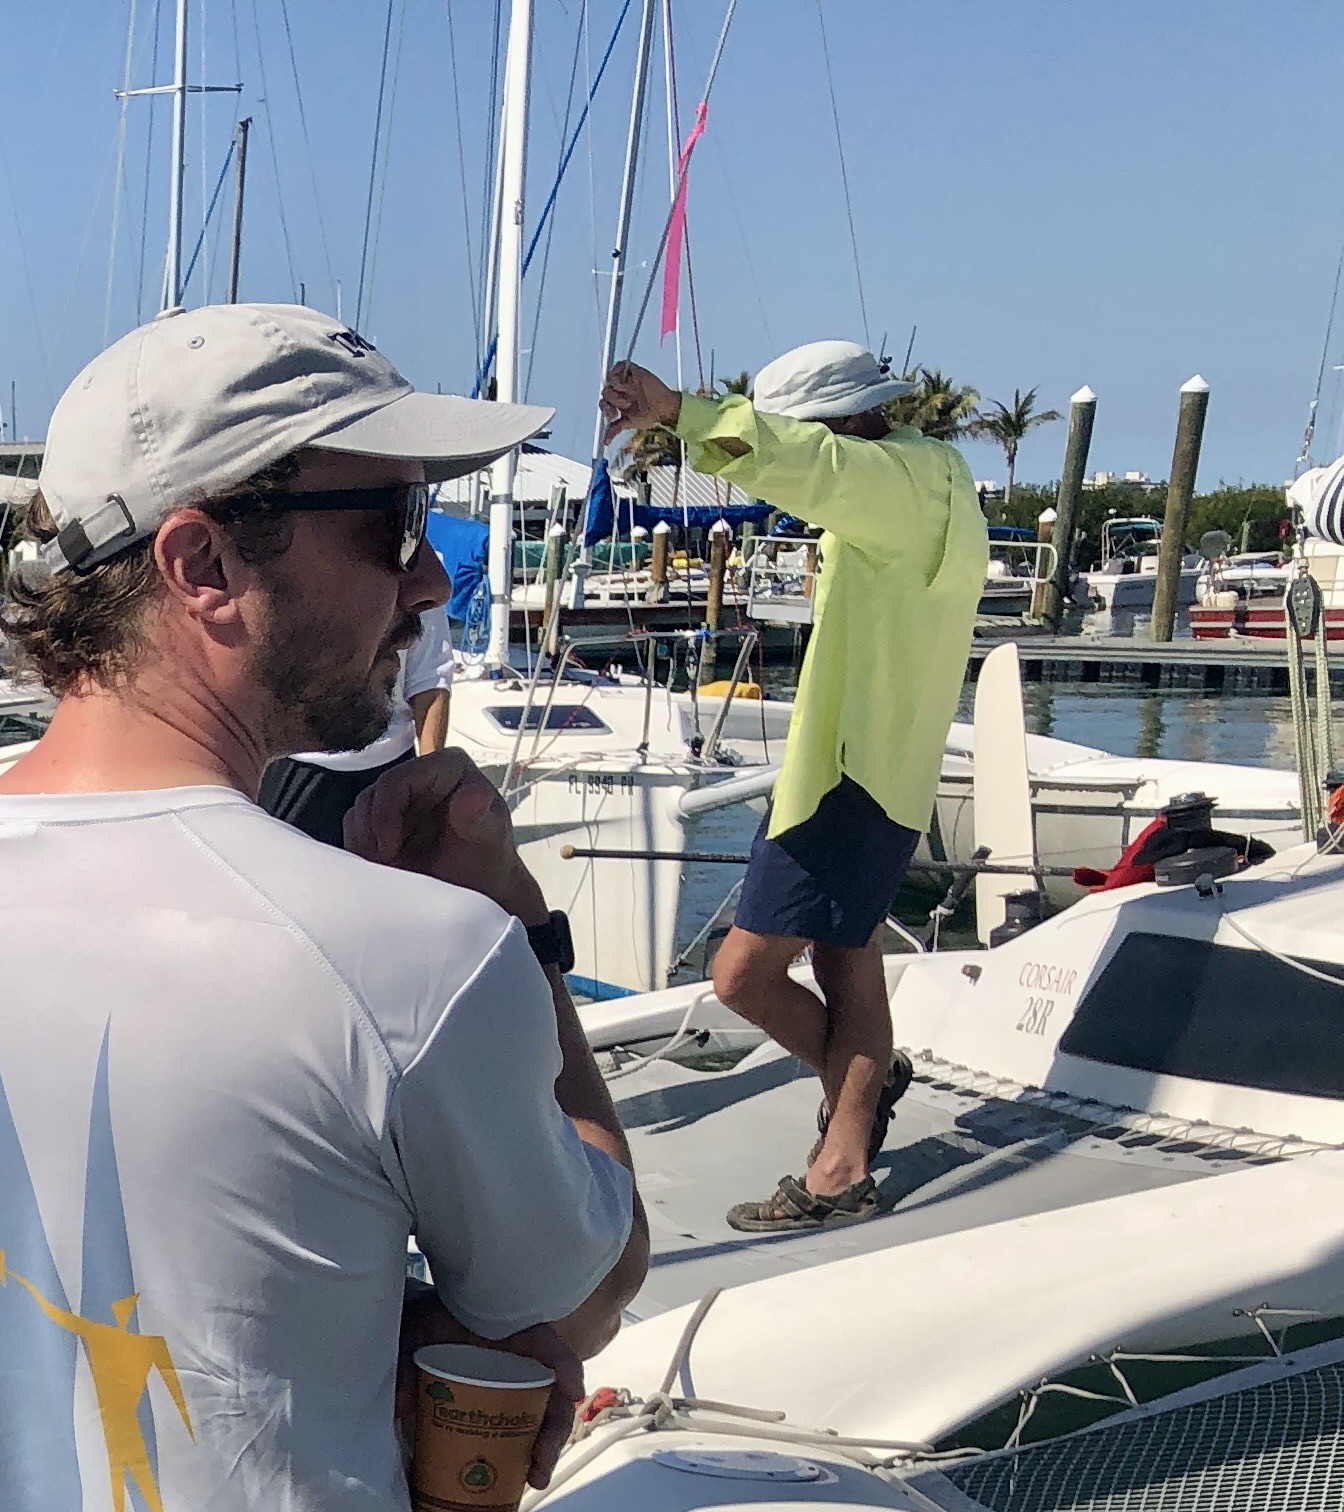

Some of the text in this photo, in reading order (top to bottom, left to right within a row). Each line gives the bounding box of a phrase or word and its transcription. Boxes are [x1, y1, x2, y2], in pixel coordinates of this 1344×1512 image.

[569, 774, 581, 794] FL
[1019, 962, 1077, 995] CORSAIR
[1015, 996, 1055, 1035] 28R
